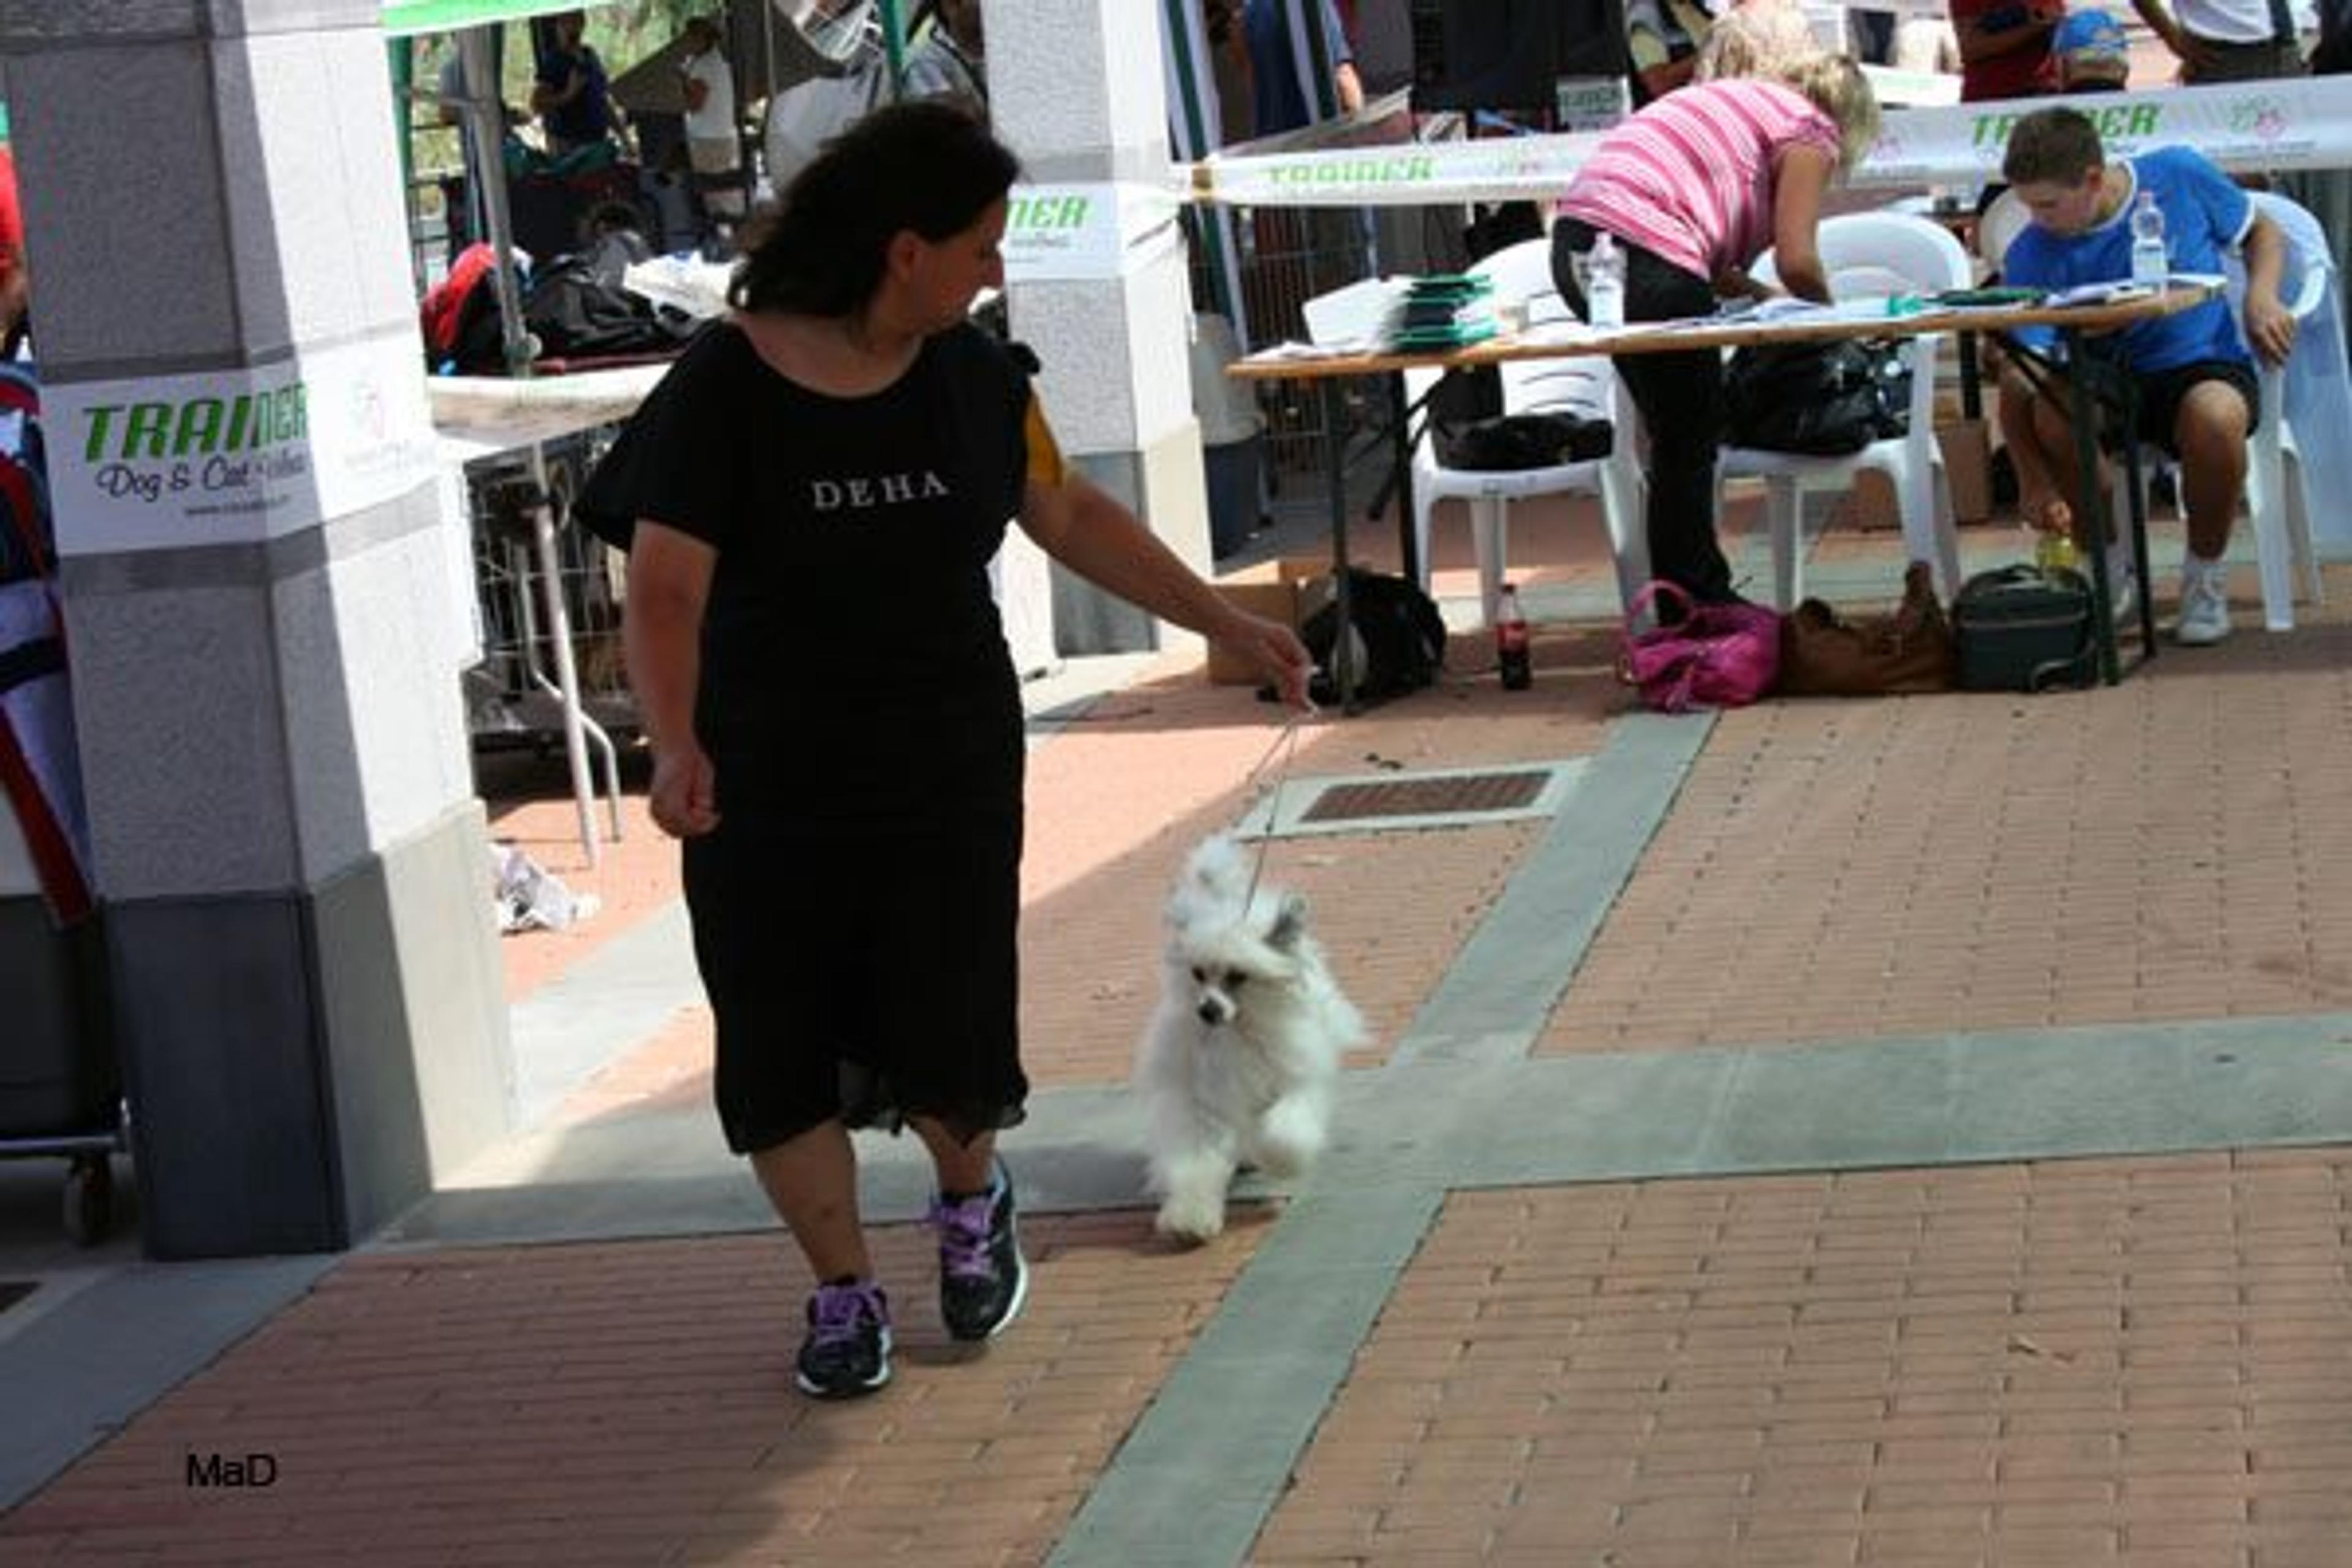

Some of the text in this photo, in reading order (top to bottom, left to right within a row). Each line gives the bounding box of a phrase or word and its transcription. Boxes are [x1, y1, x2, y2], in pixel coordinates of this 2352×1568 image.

[95, 461, 162, 502] Dog
[203, 454, 249, 491] Cat
[812, 470, 950, 511] DEHA
